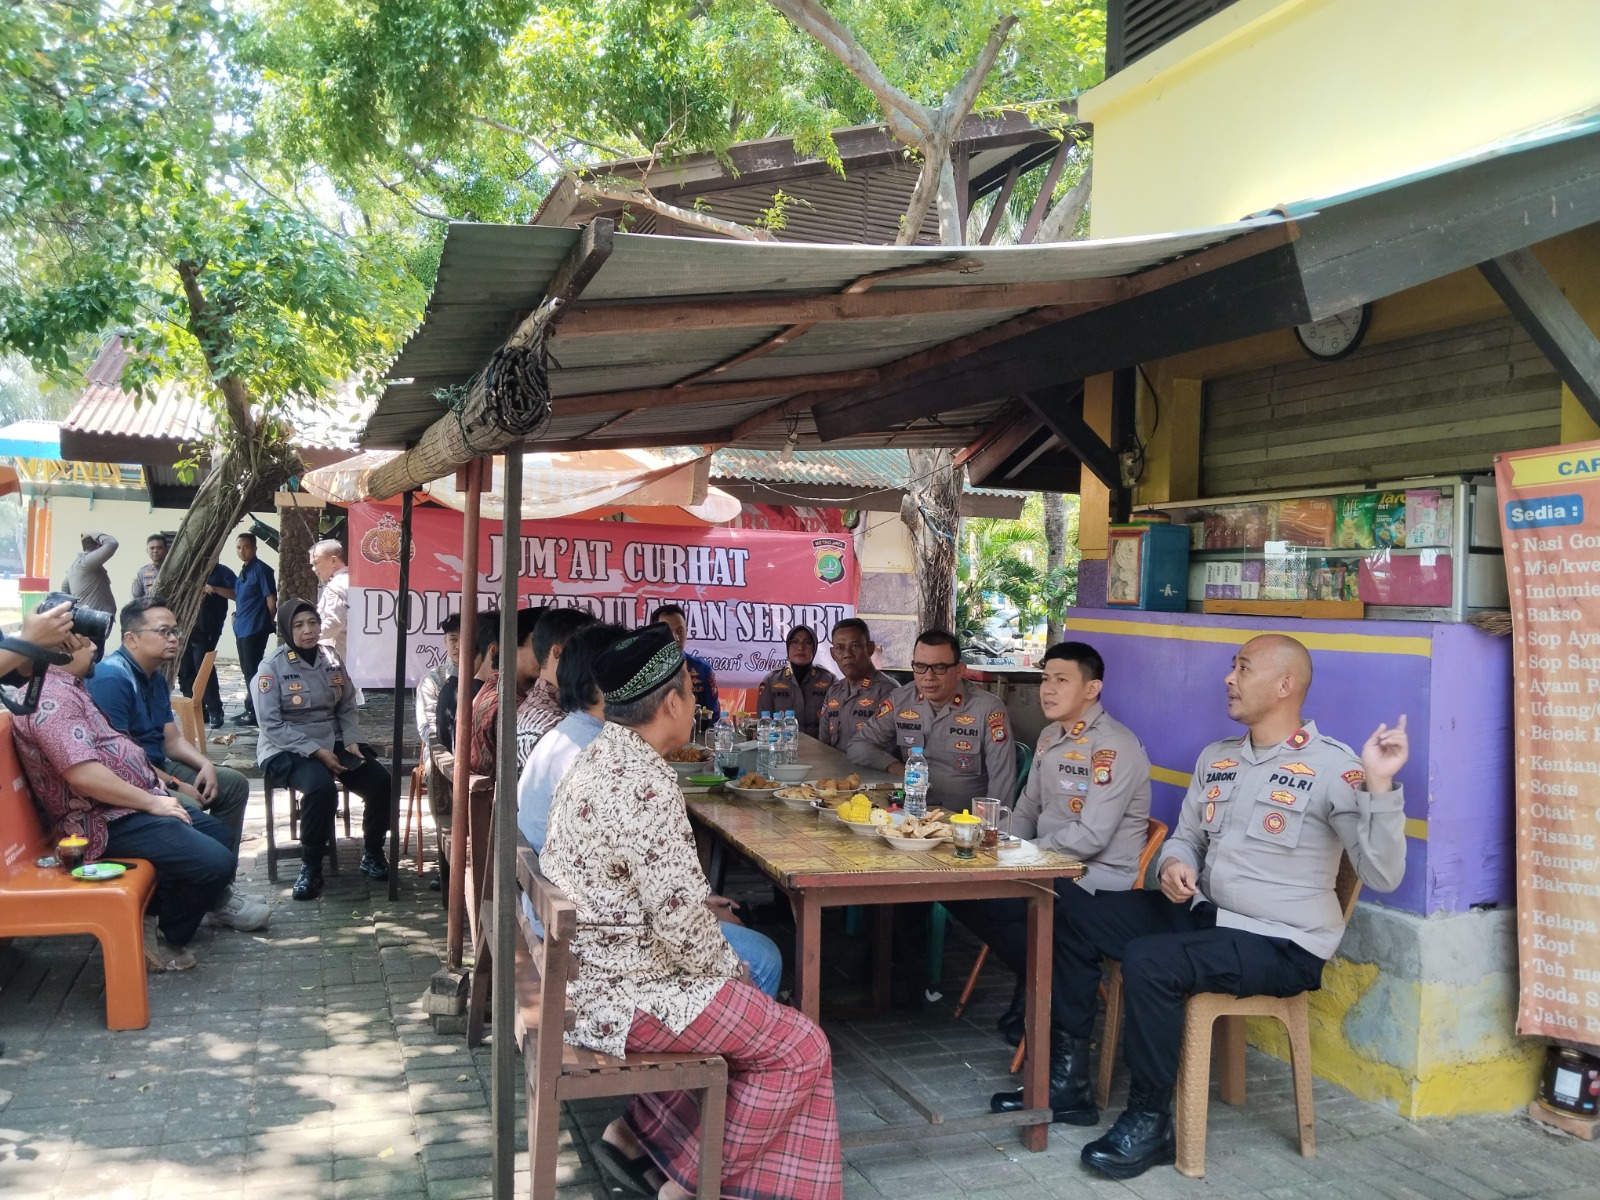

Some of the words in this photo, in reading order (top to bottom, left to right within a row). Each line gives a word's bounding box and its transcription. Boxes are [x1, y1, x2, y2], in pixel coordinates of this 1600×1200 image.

[1331, 338, 1340, 350] 6
[1511, 505, 1566, 523] Sedia
[1522, 535, 1564, 553] Nasi
[623, 541, 751, 587] CURHAT
[1525, 581, 1600, 599] Indomie
[1527, 607, 1582, 622] Bakso
[1528, 631, 1562, 650] Sop
[1529, 654, 1562, 673] Sop
[1529, 678, 1580, 697] Ayam
[1530, 701, 1600, 722] Udang/
[949, 727, 979, 737] POLRI
[1530, 725, 1587, 741] Bebek
[1058, 763, 1089, 776] POLRI
[1529, 755, 1600, 777] Kentan
[1205, 772, 1237, 784] ZAROKI
[1269, 773, 1314, 792] POLRI
[1530, 779, 1579, 797] Sosis
[1530, 802, 1576, 821] Otak
[1530, 826, 1596, 850] Pisang
[1532, 909, 1598, 935] Kelapa
[1532, 934, 1577, 957] Kopi
[1532, 958, 1567, 978] Teh
[1533, 982, 1580, 1005] Soda
[1533, 1006, 1578, 1028] Jahe
